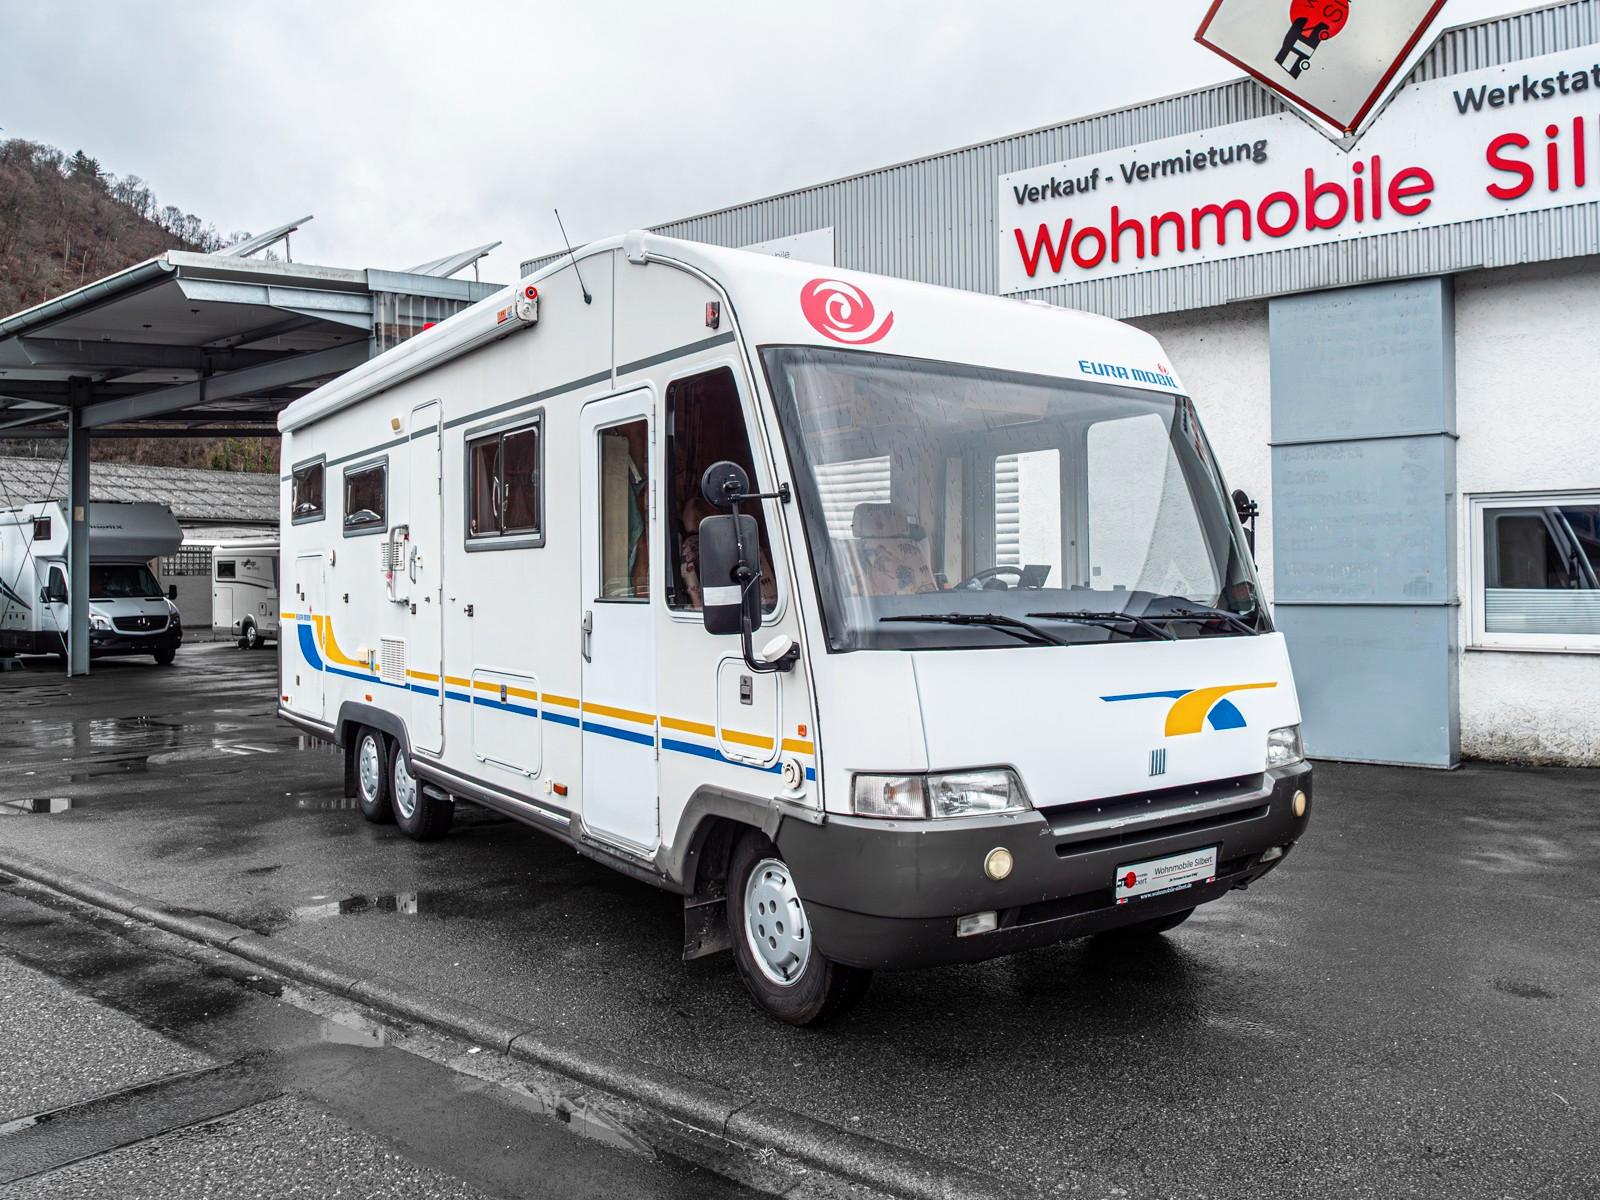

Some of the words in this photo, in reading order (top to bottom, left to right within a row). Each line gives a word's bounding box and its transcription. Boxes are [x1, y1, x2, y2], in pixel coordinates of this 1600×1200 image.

[1013, 168, 1100, 205] Verkauf
[1120, 139, 1268, 185] Vermietung
[1014, 154, 1435, 278] Wohnmobile
[1486, 114, 1600, 200] Sil
[1078, 360, 1130, 380] EURA
[1154, 860, 1194, 876] Wohnmobile
[1194, 856, 1213, 867] Silbert
